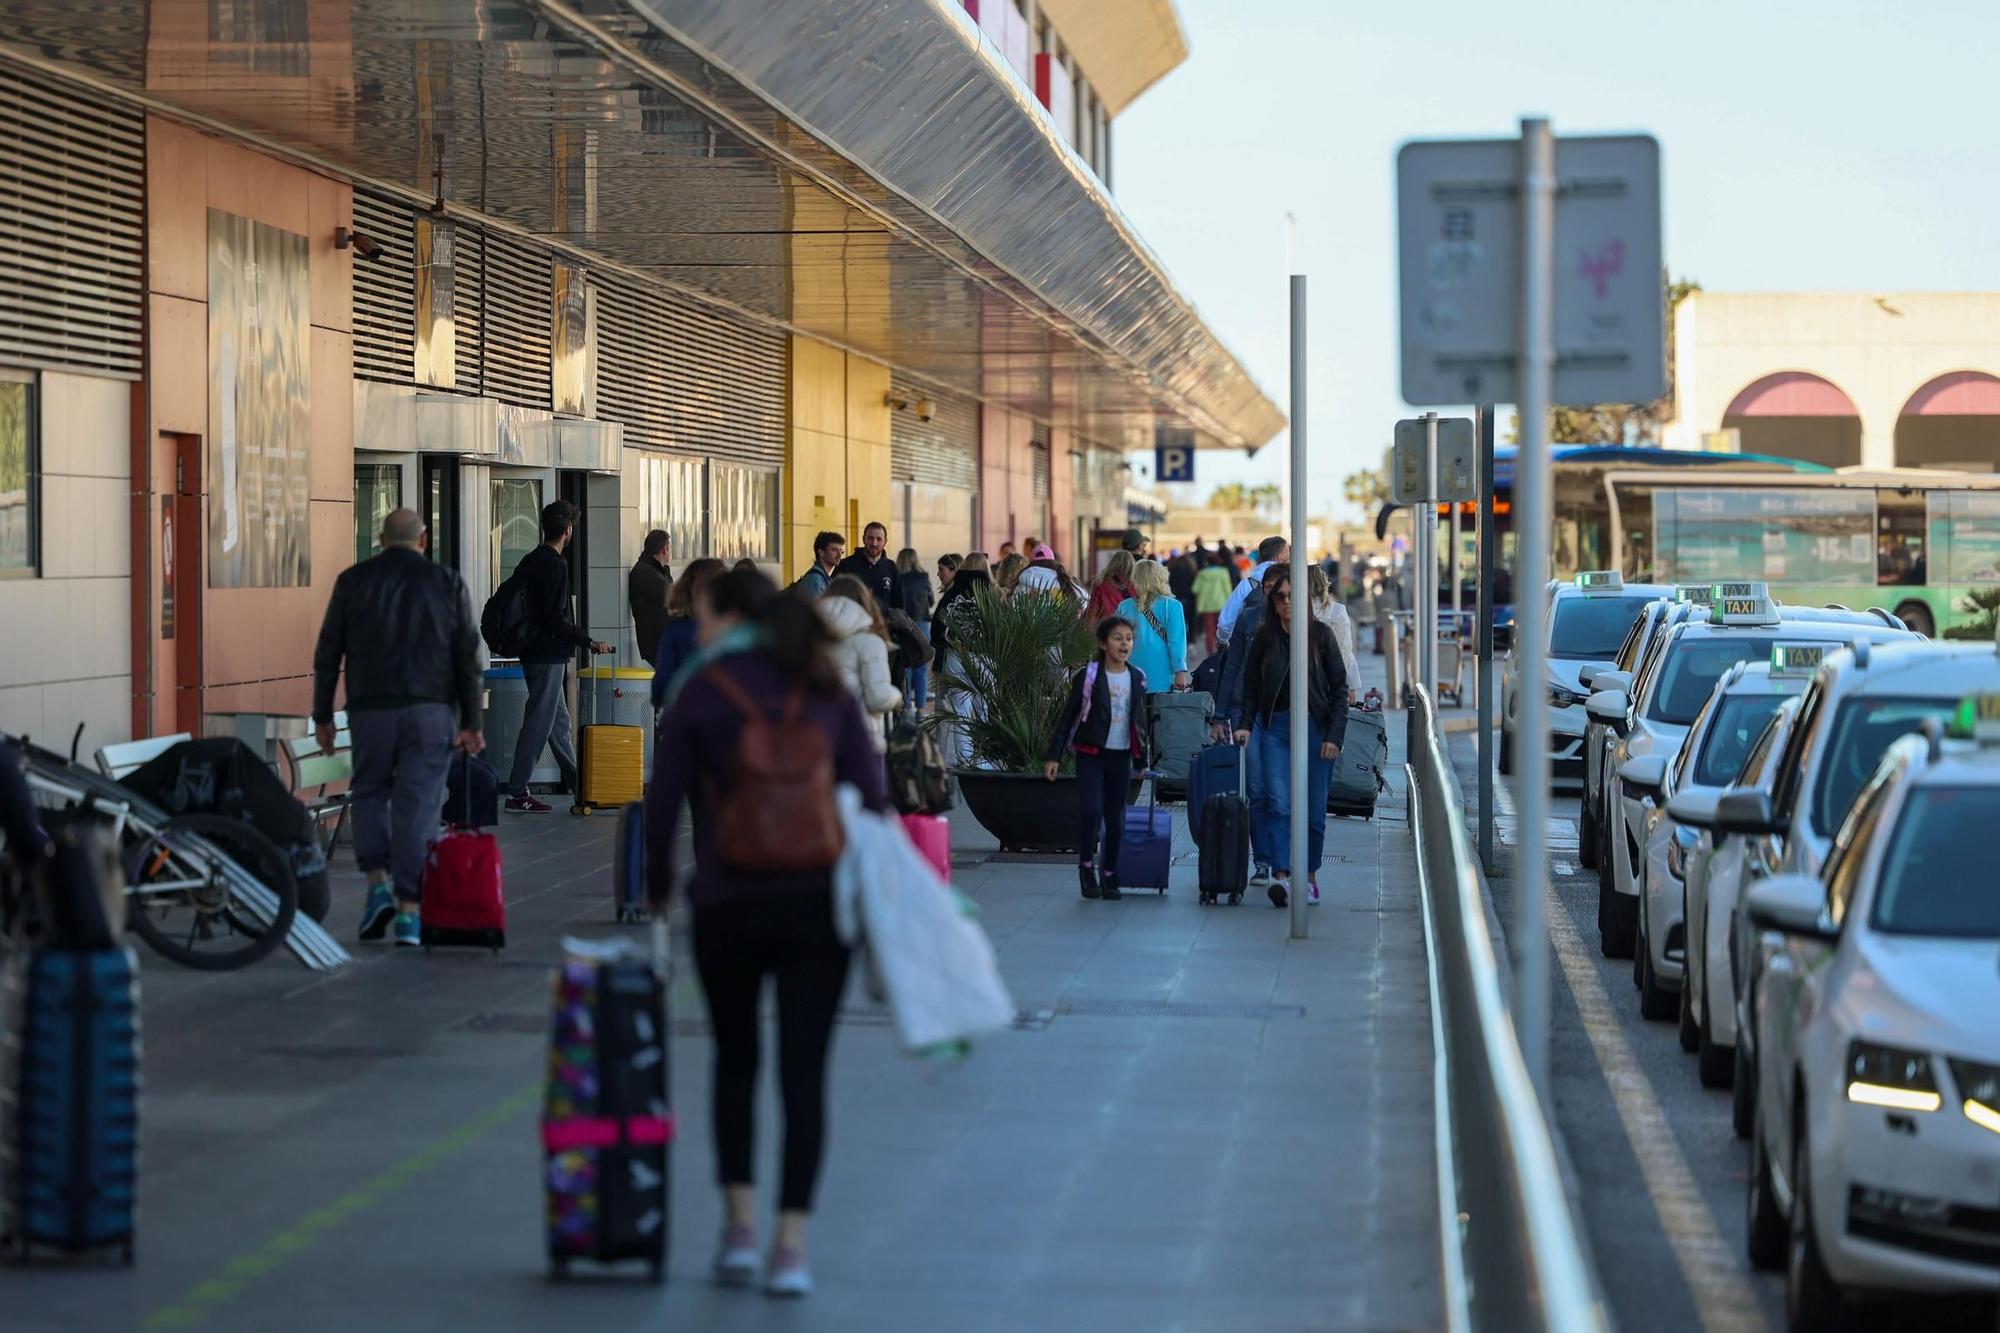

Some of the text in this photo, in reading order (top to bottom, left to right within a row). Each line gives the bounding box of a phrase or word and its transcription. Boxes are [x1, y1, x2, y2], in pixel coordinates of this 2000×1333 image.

[1163, 448, 1186, 477] P
[1725, 600, 1753, 614] TAXI
[1788, 648, 1821, 665] TAXI
